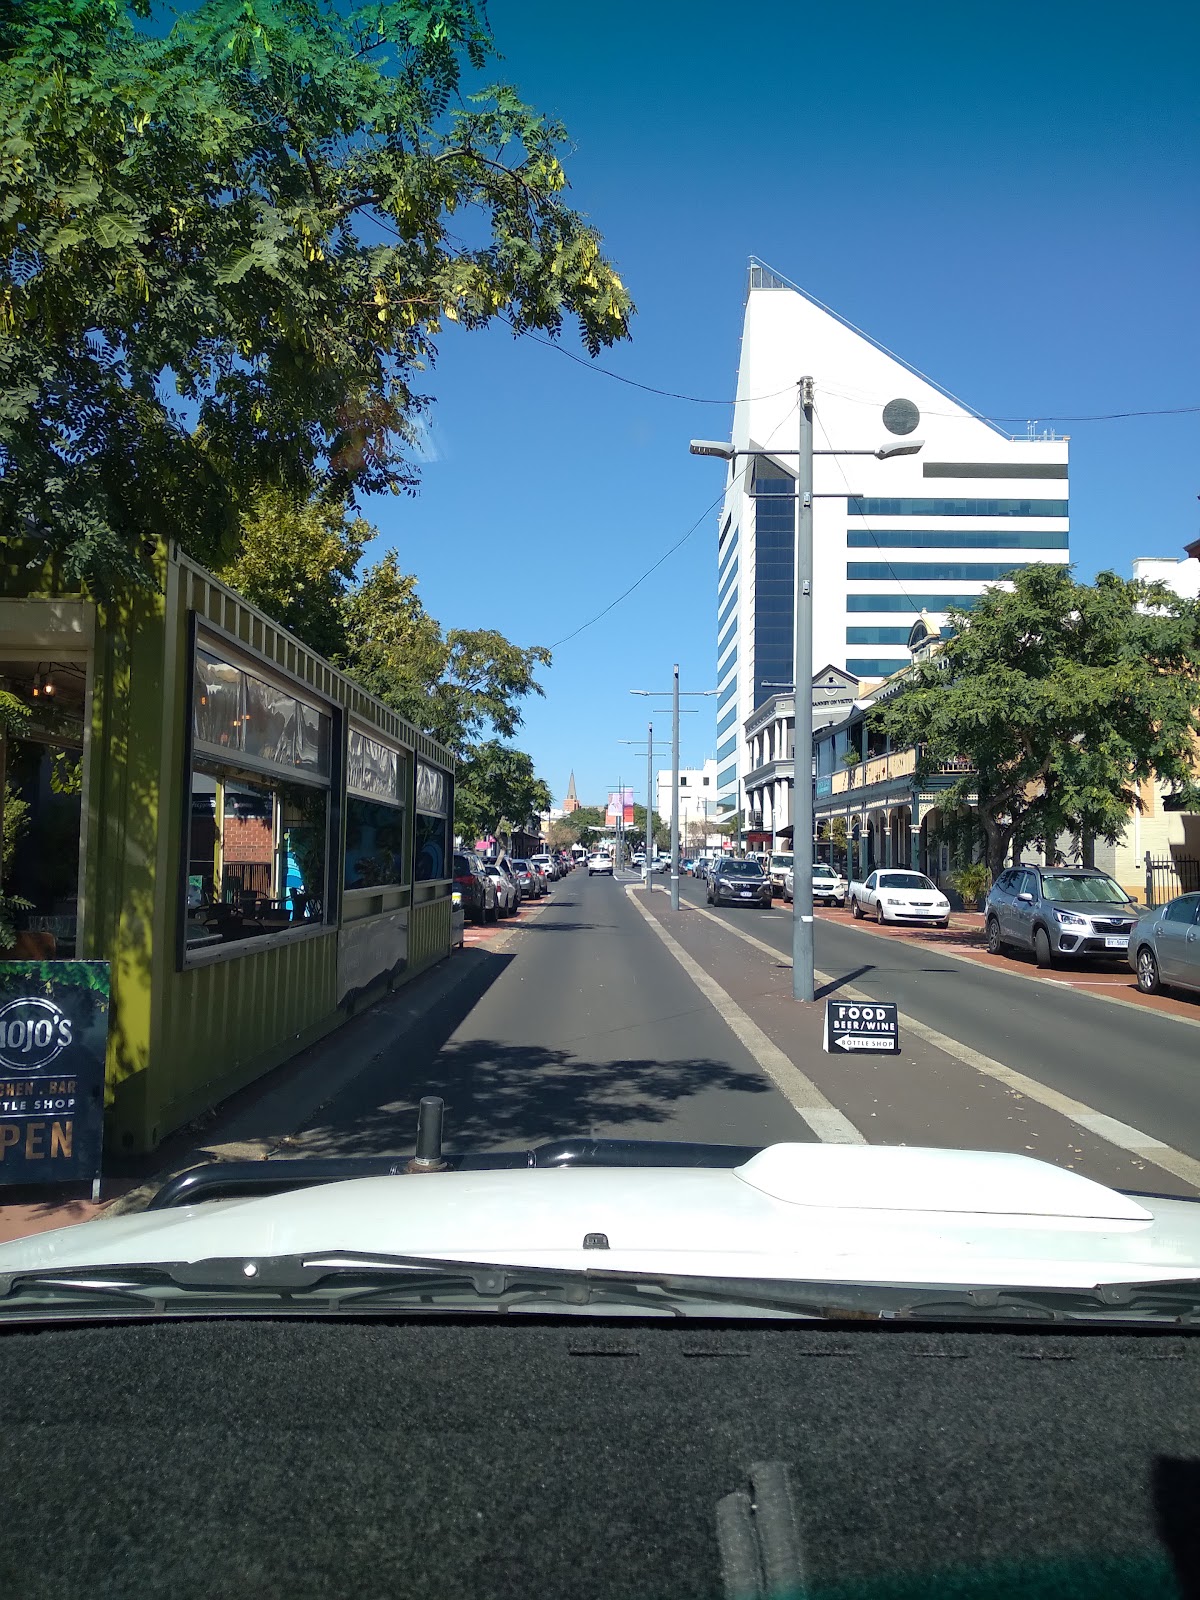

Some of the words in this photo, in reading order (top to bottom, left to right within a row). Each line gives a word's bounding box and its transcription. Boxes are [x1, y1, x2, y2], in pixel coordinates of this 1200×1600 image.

[839, 1007, 886, 1020] FOOD
[834, 1020, 895, 1030] BEER/WINE
[49, 1081, 76, 1095] BAR
[34, 1098, 75, 1110] SHOP
